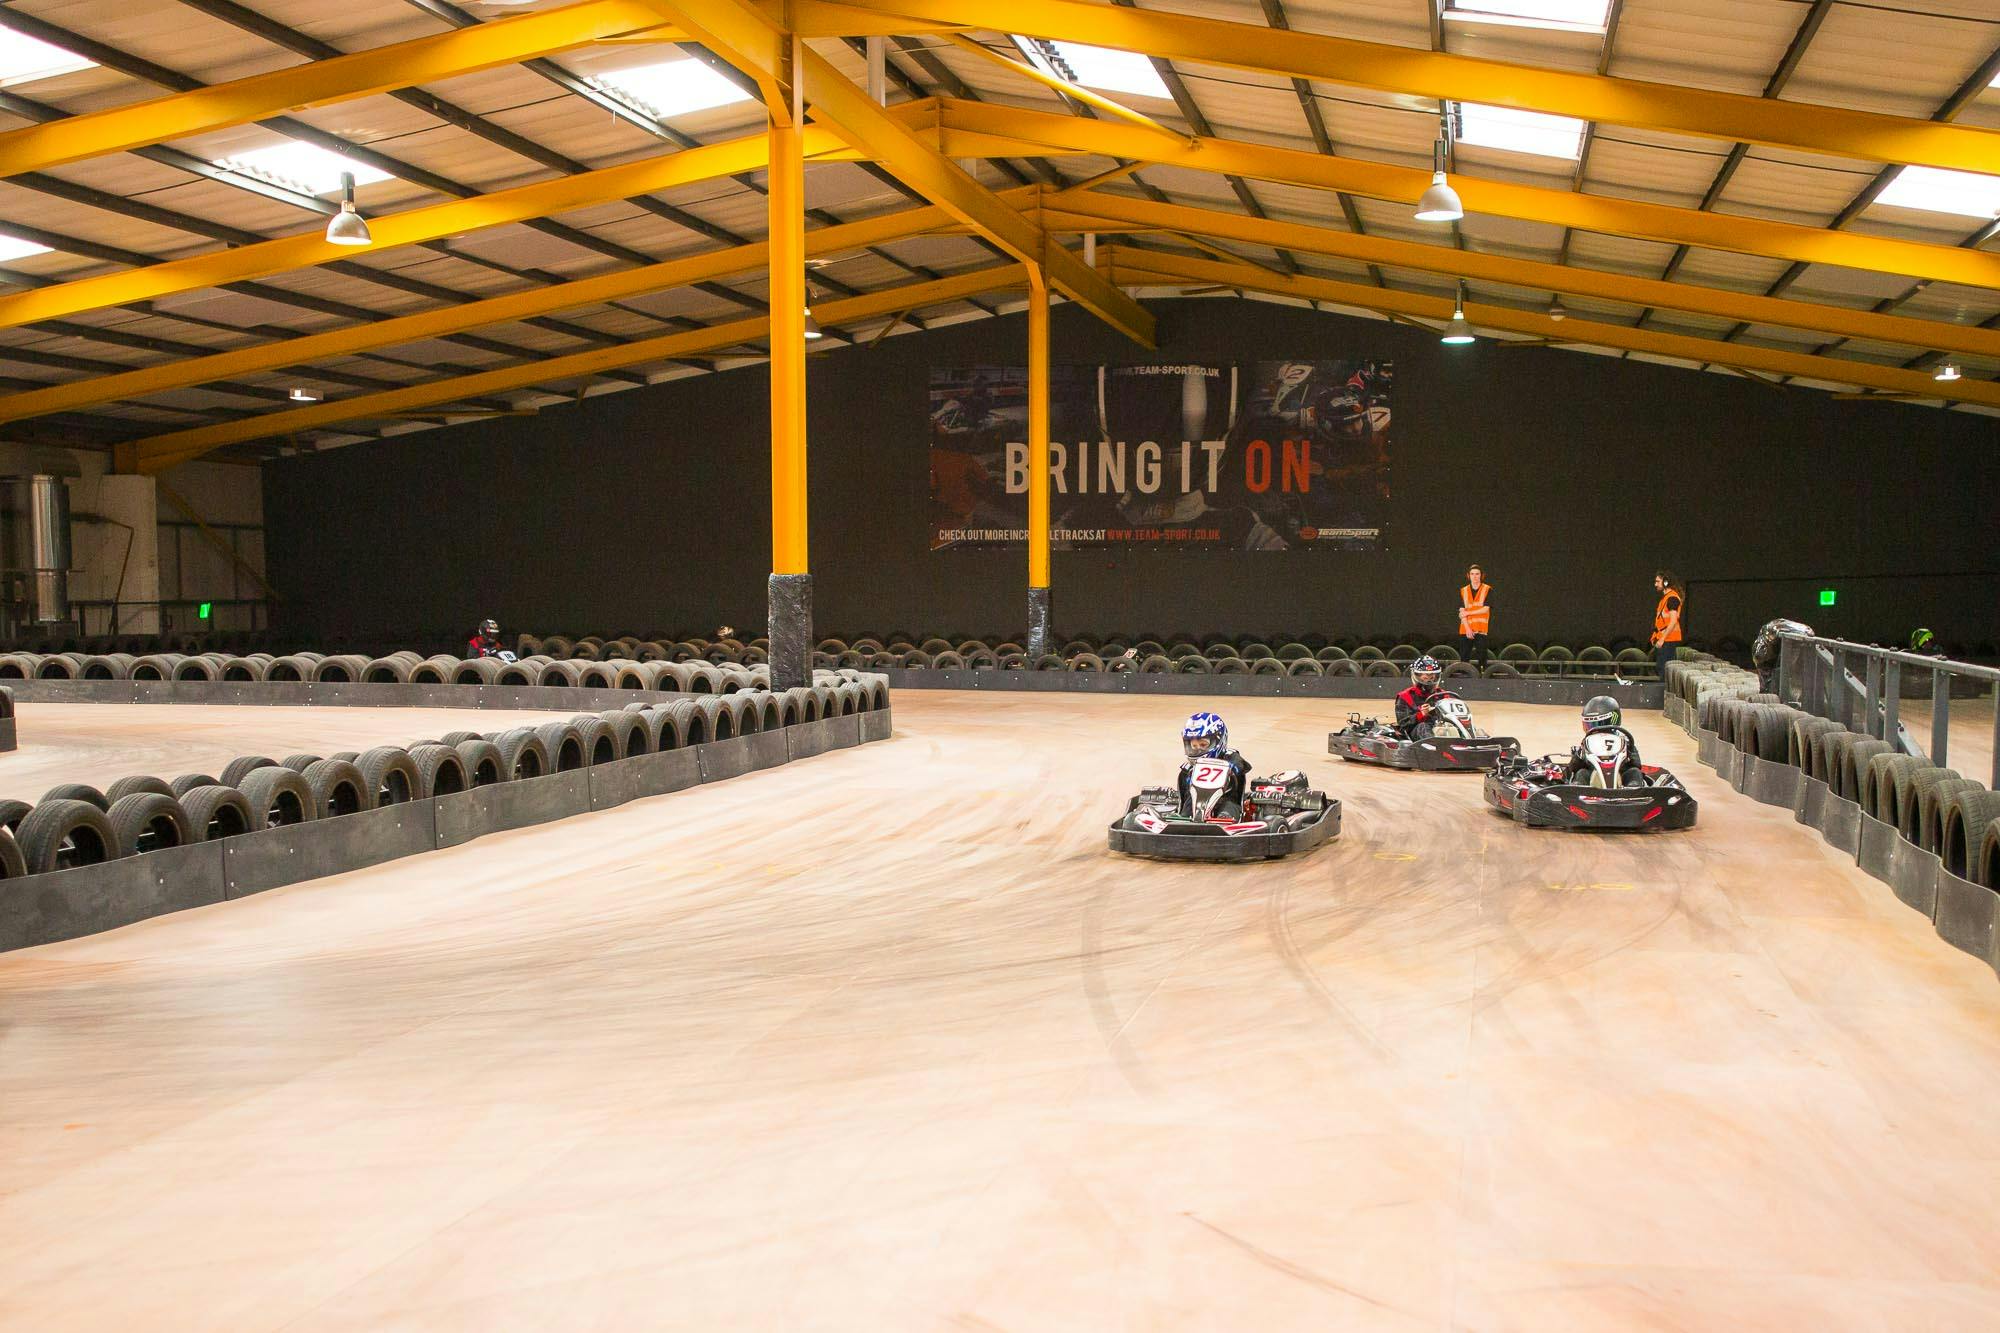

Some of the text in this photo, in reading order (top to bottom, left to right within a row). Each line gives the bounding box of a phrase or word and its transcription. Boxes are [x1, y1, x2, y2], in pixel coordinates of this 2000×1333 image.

[1005, 440, 1311, 494] BRING IT ON
[939, 529, 966, 541] CHECK
[967, 529, 985, 541] OUT
[985, 529, 1009, 541] MORE
[1060, 529, 1095, 541] TRACKS
[1095, 529, 1106, 541] AT
[1196, 767, 1224, 783] 27
